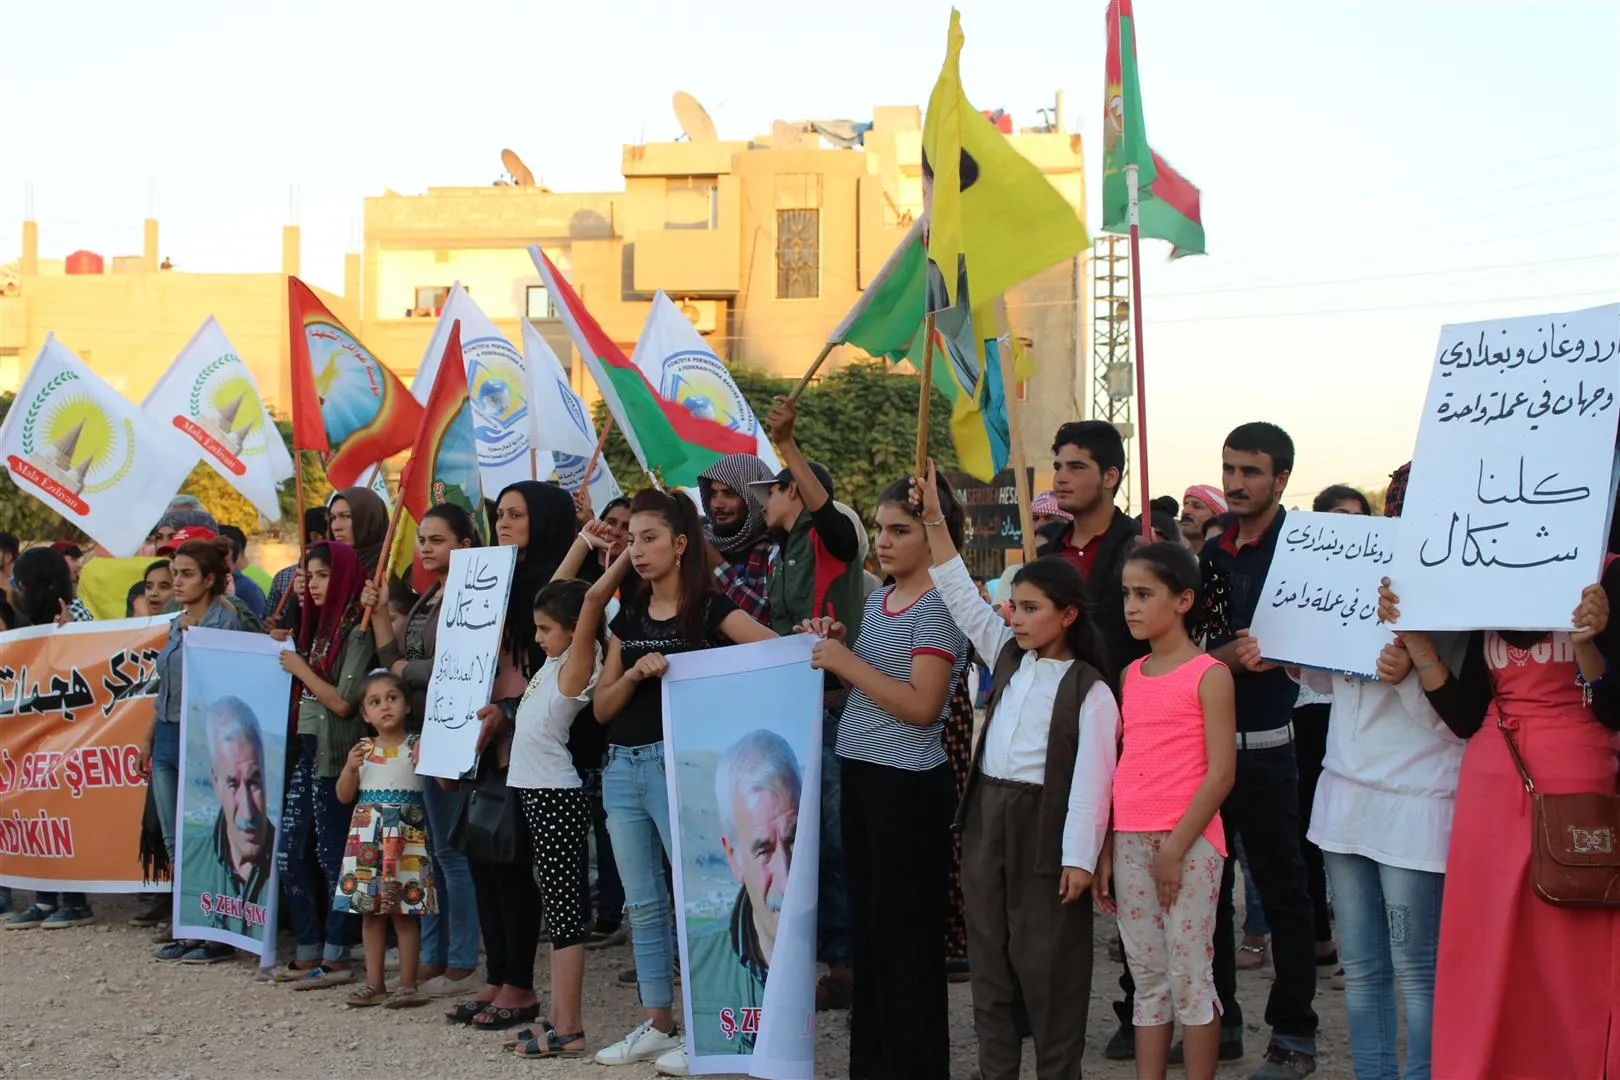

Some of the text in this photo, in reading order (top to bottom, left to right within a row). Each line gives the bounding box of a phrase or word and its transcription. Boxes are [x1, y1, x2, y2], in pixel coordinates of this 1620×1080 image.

[1437, 379, 1614, 431] وجهان في عملة واحدة
[184, 421, 203, 440] Mala
[16, 461, 40, 483] Mala
[1477, 455, 1590, 504] كلنا
[1345, 531, 1393, 564] دوغان
[1420, 511, 1578, 568] شنكال
[464, 556, 498, 590] كلنا
[446, 590, 498, 630] شنكال
[1272, 580, 1310, 608] واحدة
[1340, 588, 1360, 626] في
